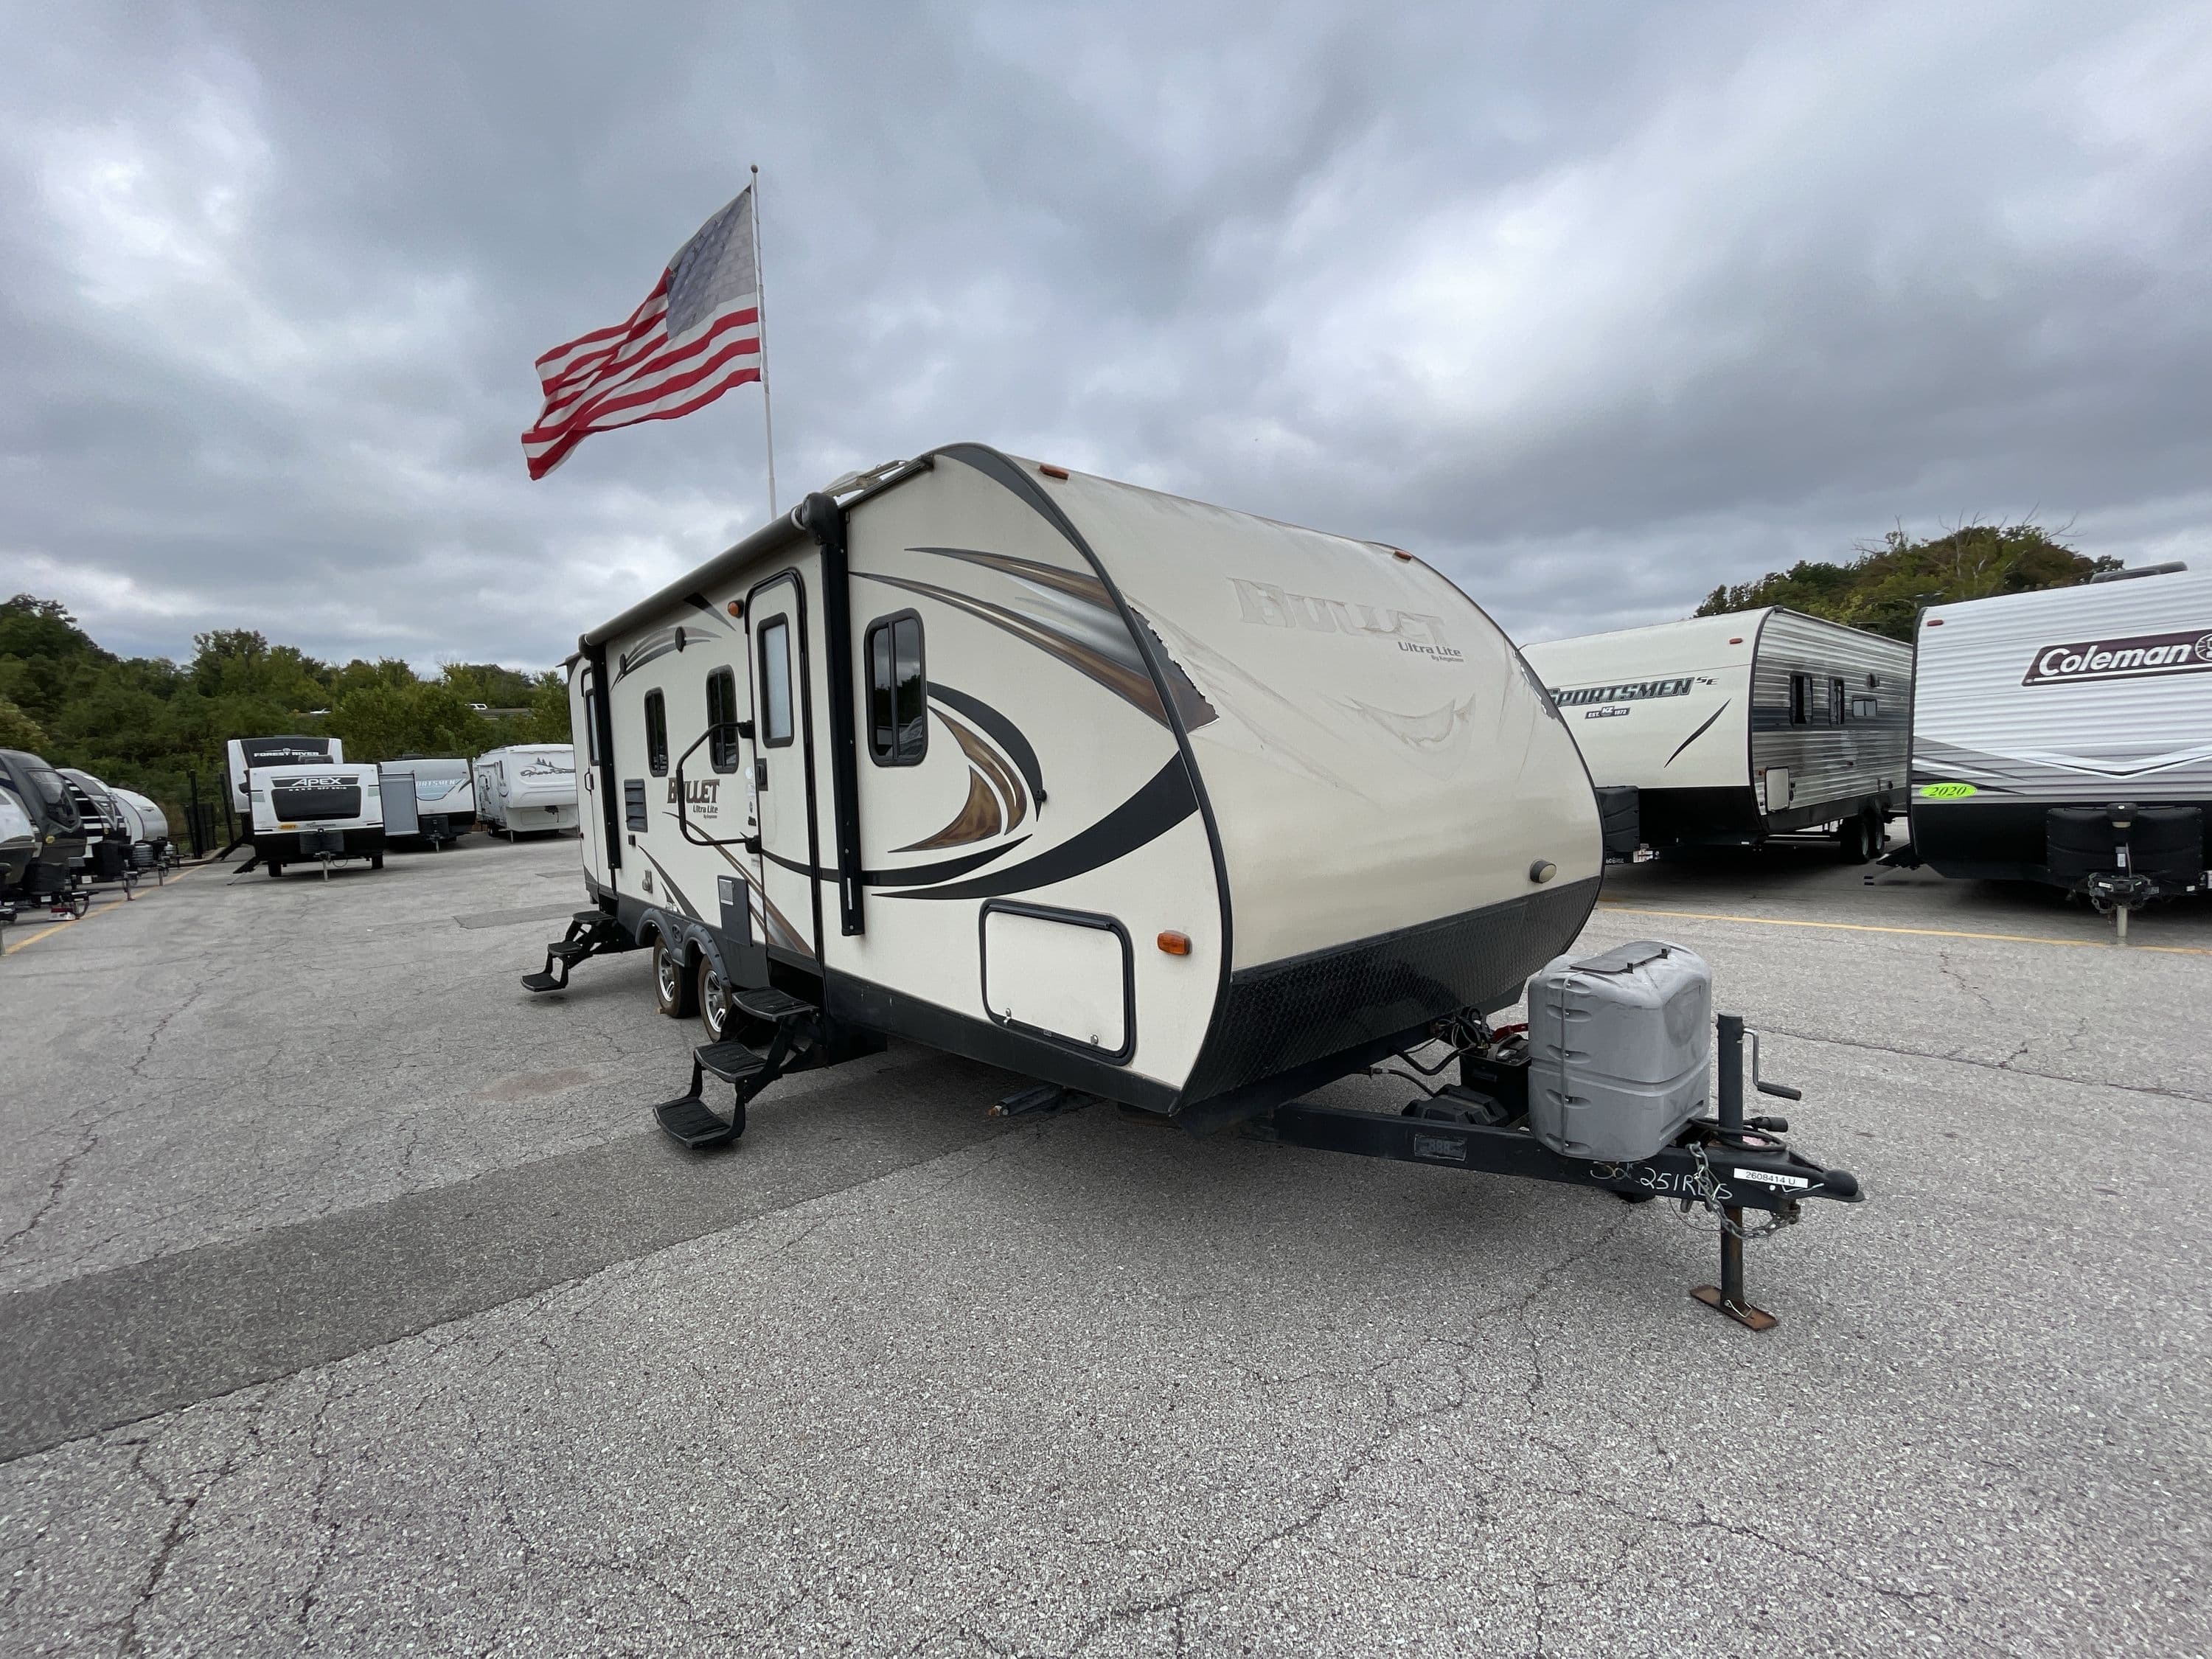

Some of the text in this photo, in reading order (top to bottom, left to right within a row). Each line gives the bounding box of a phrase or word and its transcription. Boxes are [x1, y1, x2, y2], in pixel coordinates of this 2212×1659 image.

[1225, 576, 1448, 645] BULLET
[1397, 641, 1462, 657] Ultra Lite
[2038, 643, 2193, 676] Coleman
[1696, 676, 1720, 686] SE
[1601, 706, 1614, 714] KZ
[291, 777, 342, 787] APEX
[415, 779, 456, 787] ORTSMEN
[667, 776, 720, 804] BLLET
[1928, 786, 1967, 796] 2020
[692, 804, 718, 813] Ultra Lite
[1745, 1171, 1786, 1183] 2608414
